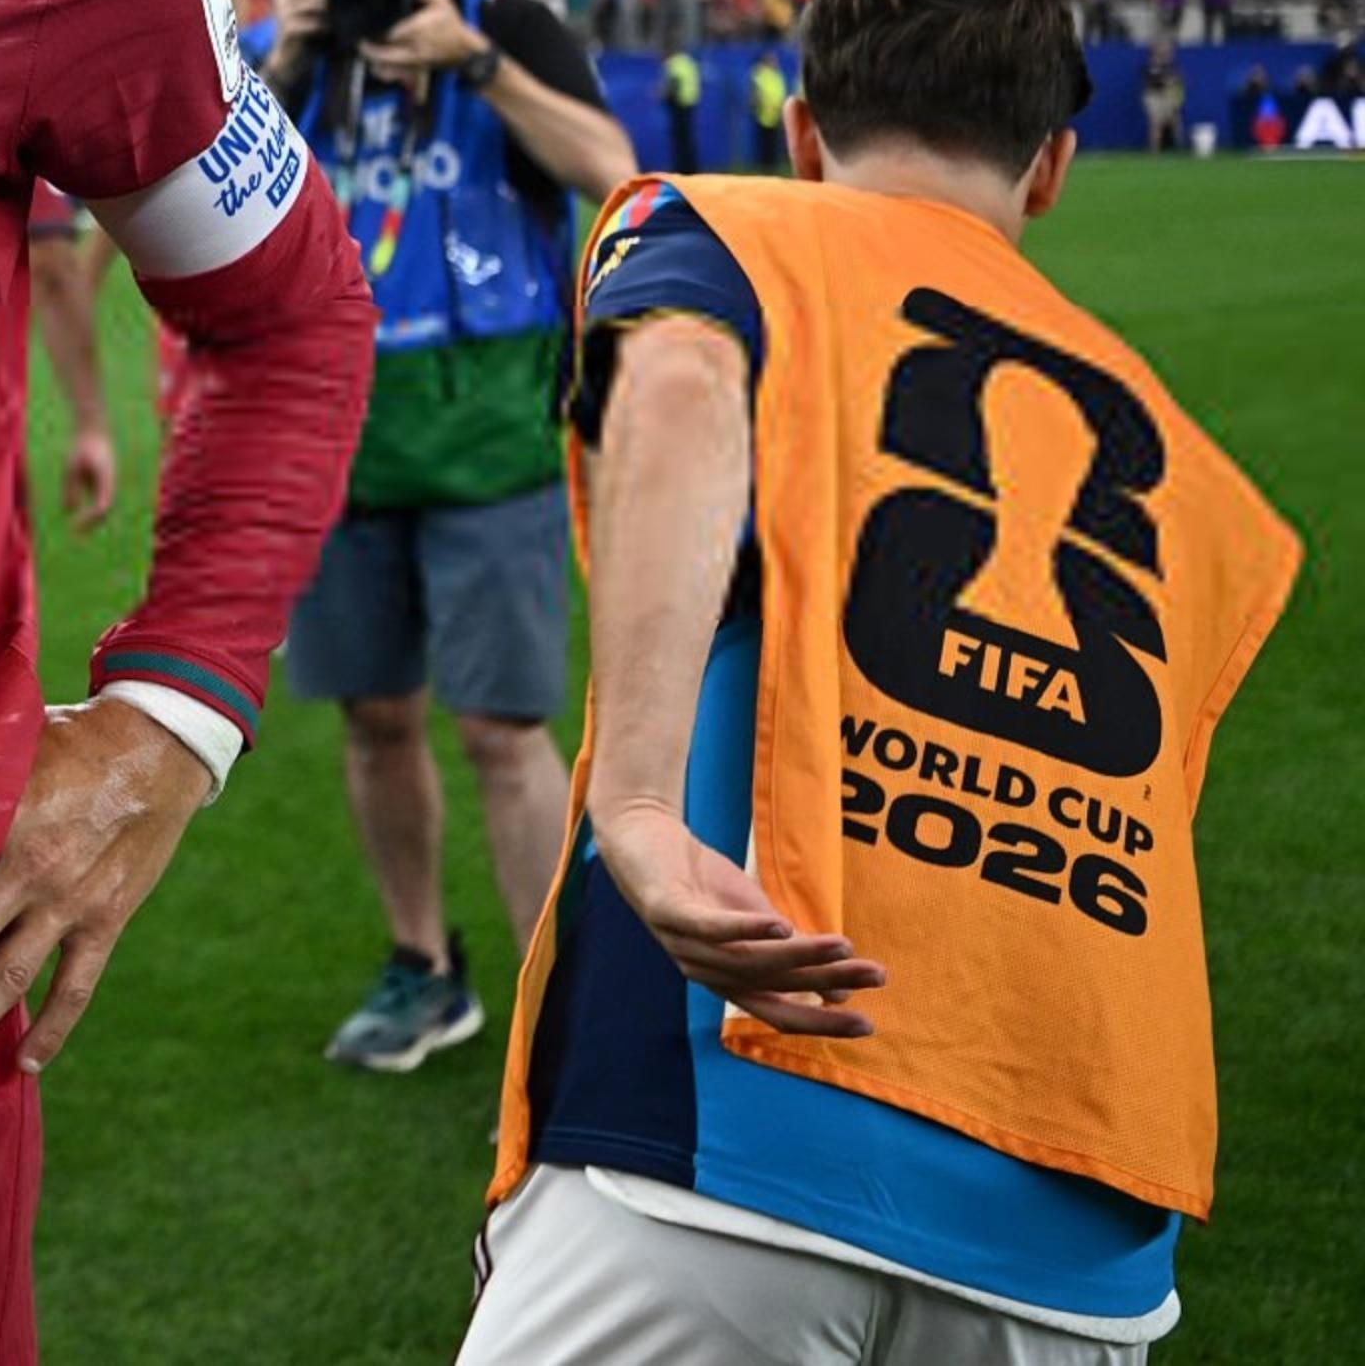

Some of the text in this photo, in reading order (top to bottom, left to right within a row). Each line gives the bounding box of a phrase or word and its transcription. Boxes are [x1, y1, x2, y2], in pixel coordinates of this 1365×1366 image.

[1295, 96, 1365, 149] A
[213, 171, 262, 217] the
[938, 628, 1087, 725] FIFA
[840, 714, 1155, 857] WORLD CUP
[841, 767, 1149, 937] 2026
